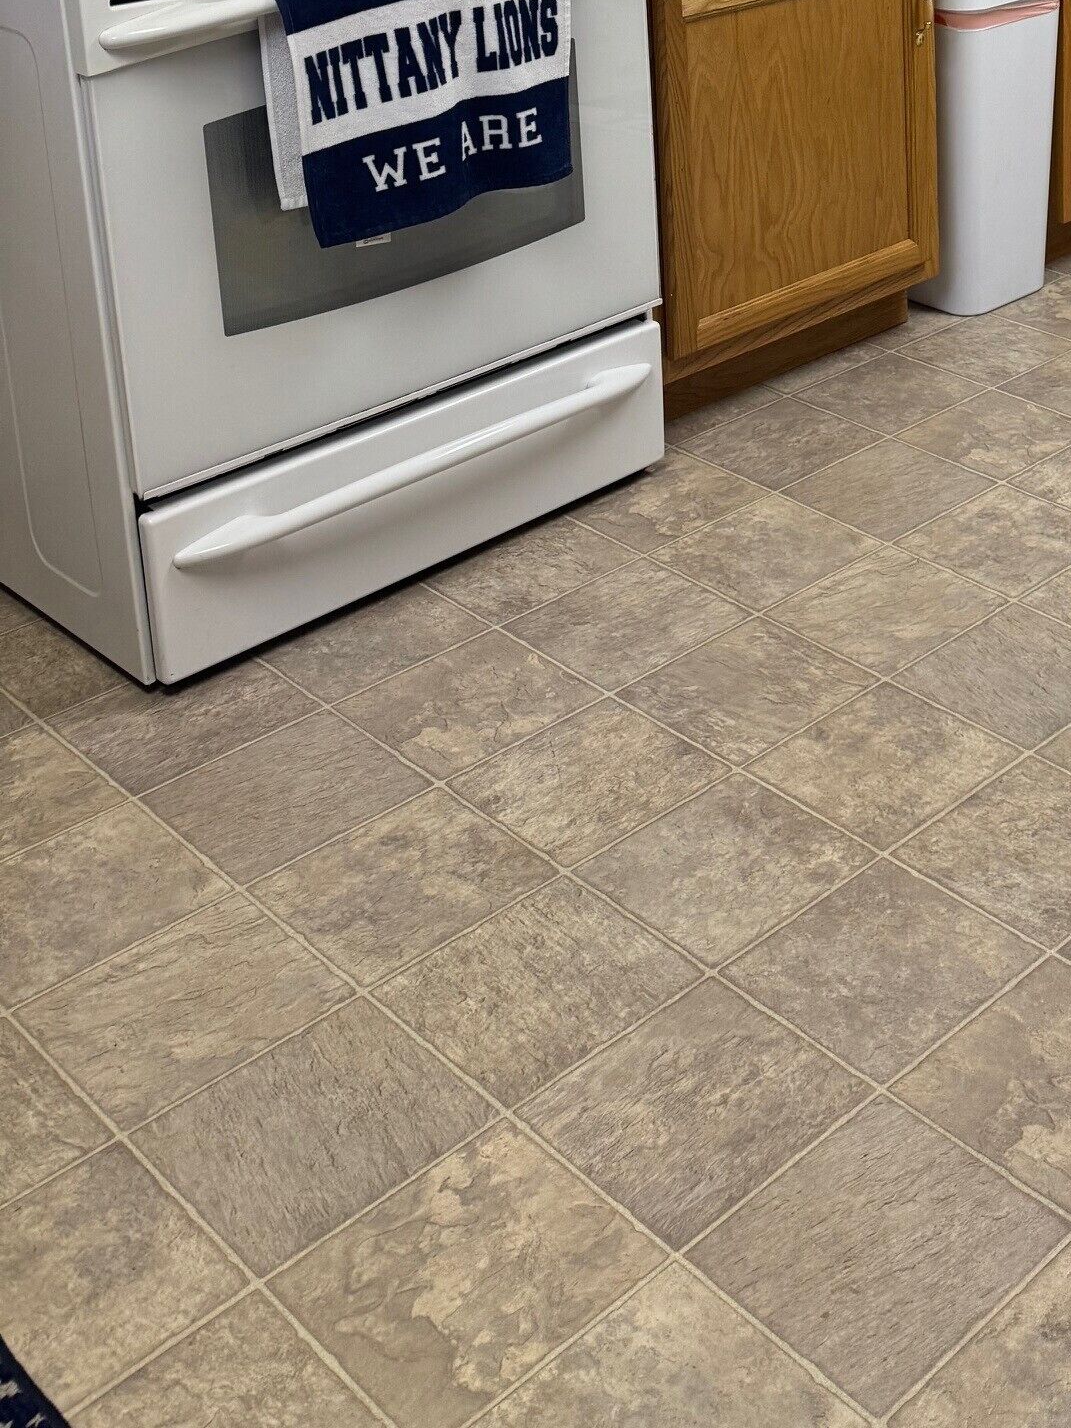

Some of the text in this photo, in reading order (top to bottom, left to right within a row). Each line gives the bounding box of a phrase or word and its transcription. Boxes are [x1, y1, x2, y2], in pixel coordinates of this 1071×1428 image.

[304, 10, 462, 125] NITTANY
[362, 107, 543, 192] WE ARE
